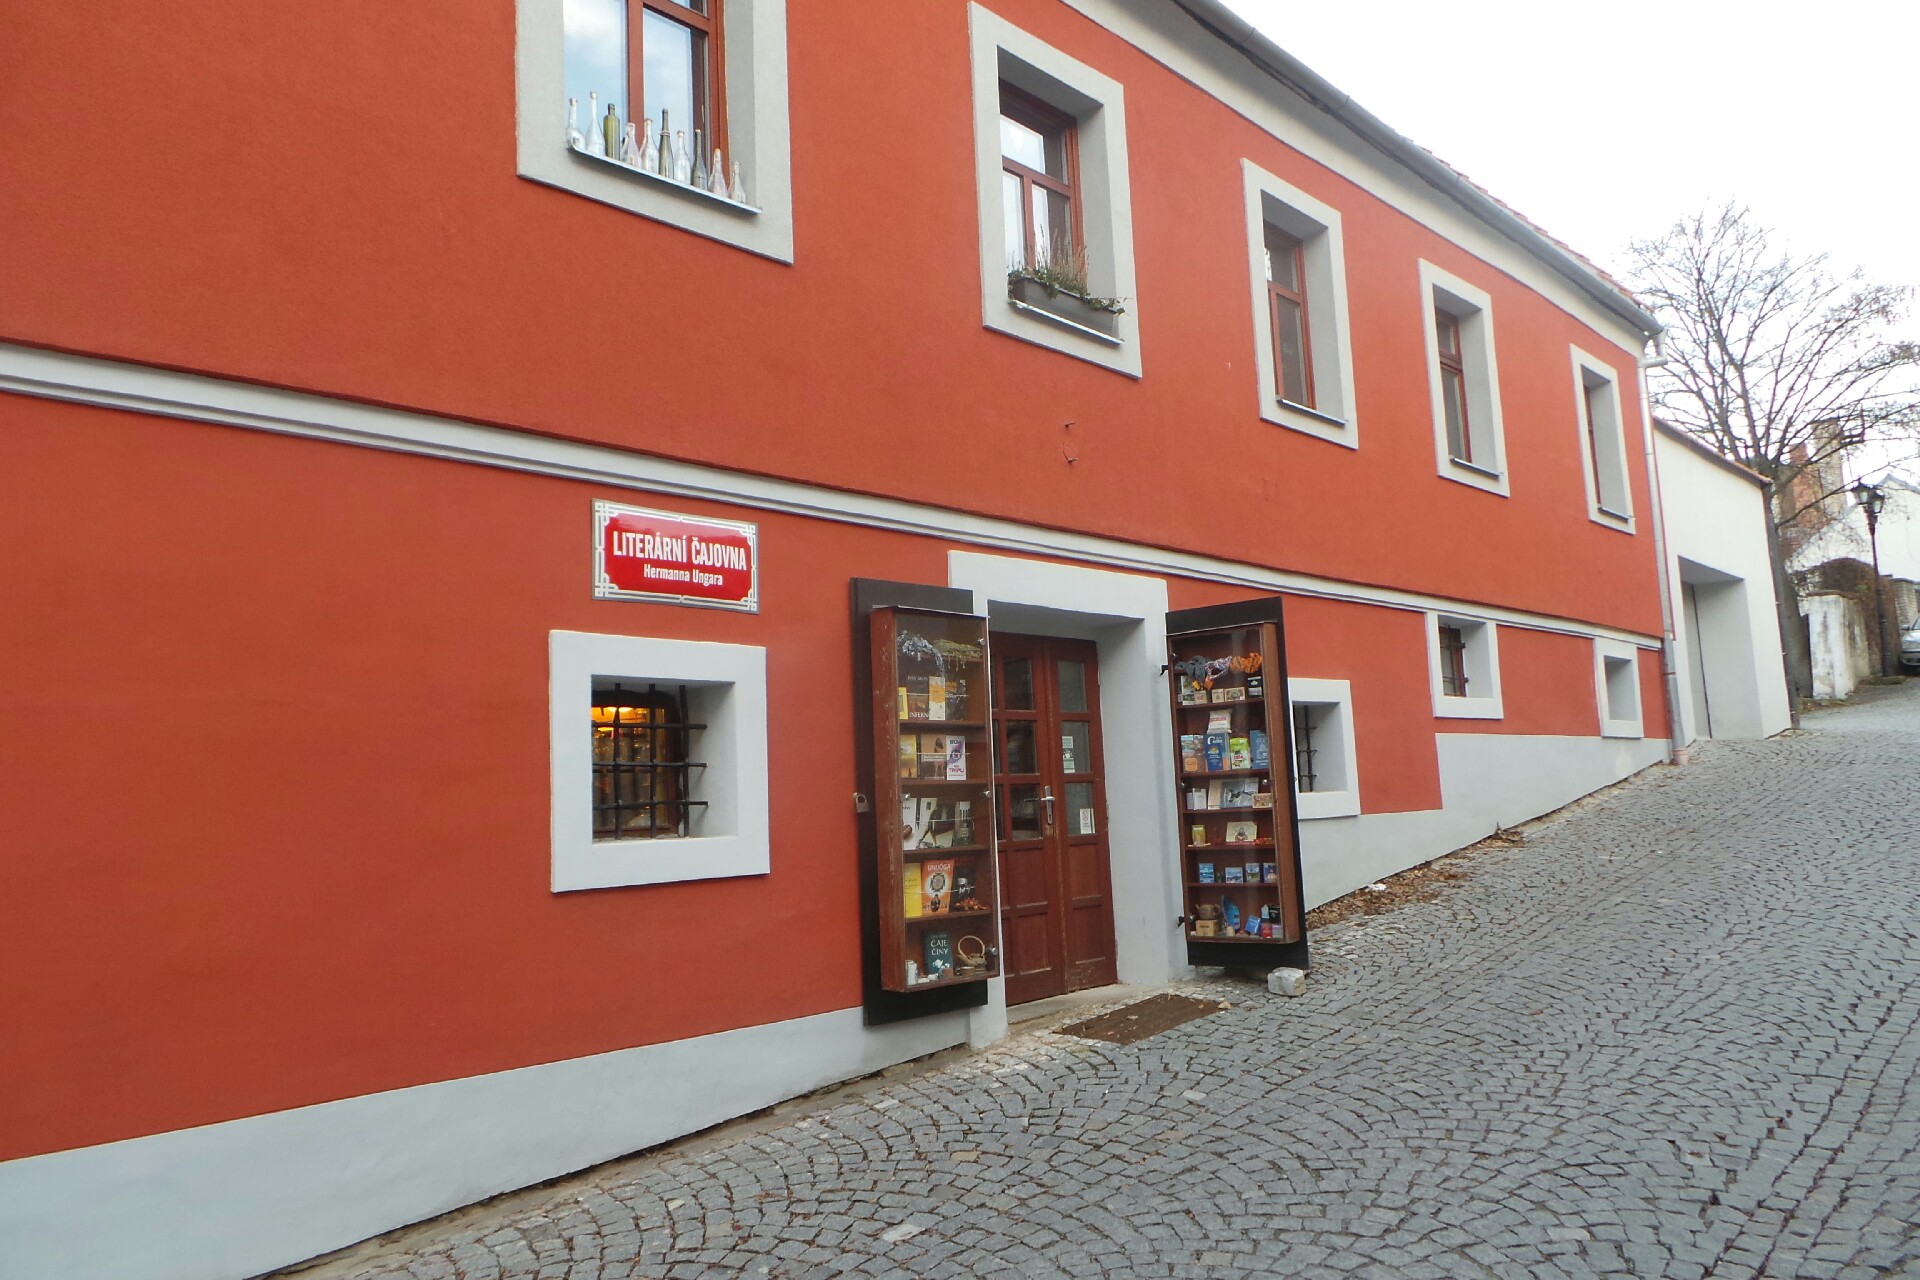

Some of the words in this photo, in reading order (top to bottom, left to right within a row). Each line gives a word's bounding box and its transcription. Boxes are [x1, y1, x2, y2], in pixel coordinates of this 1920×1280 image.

[613, 531, 687, 563] LITERÁRNÍ
[691, 536, 747, 571] ČAJOVNA
[644, 564, 690, 582] Hermanna
[692, 569, 723, 587] Ungara
